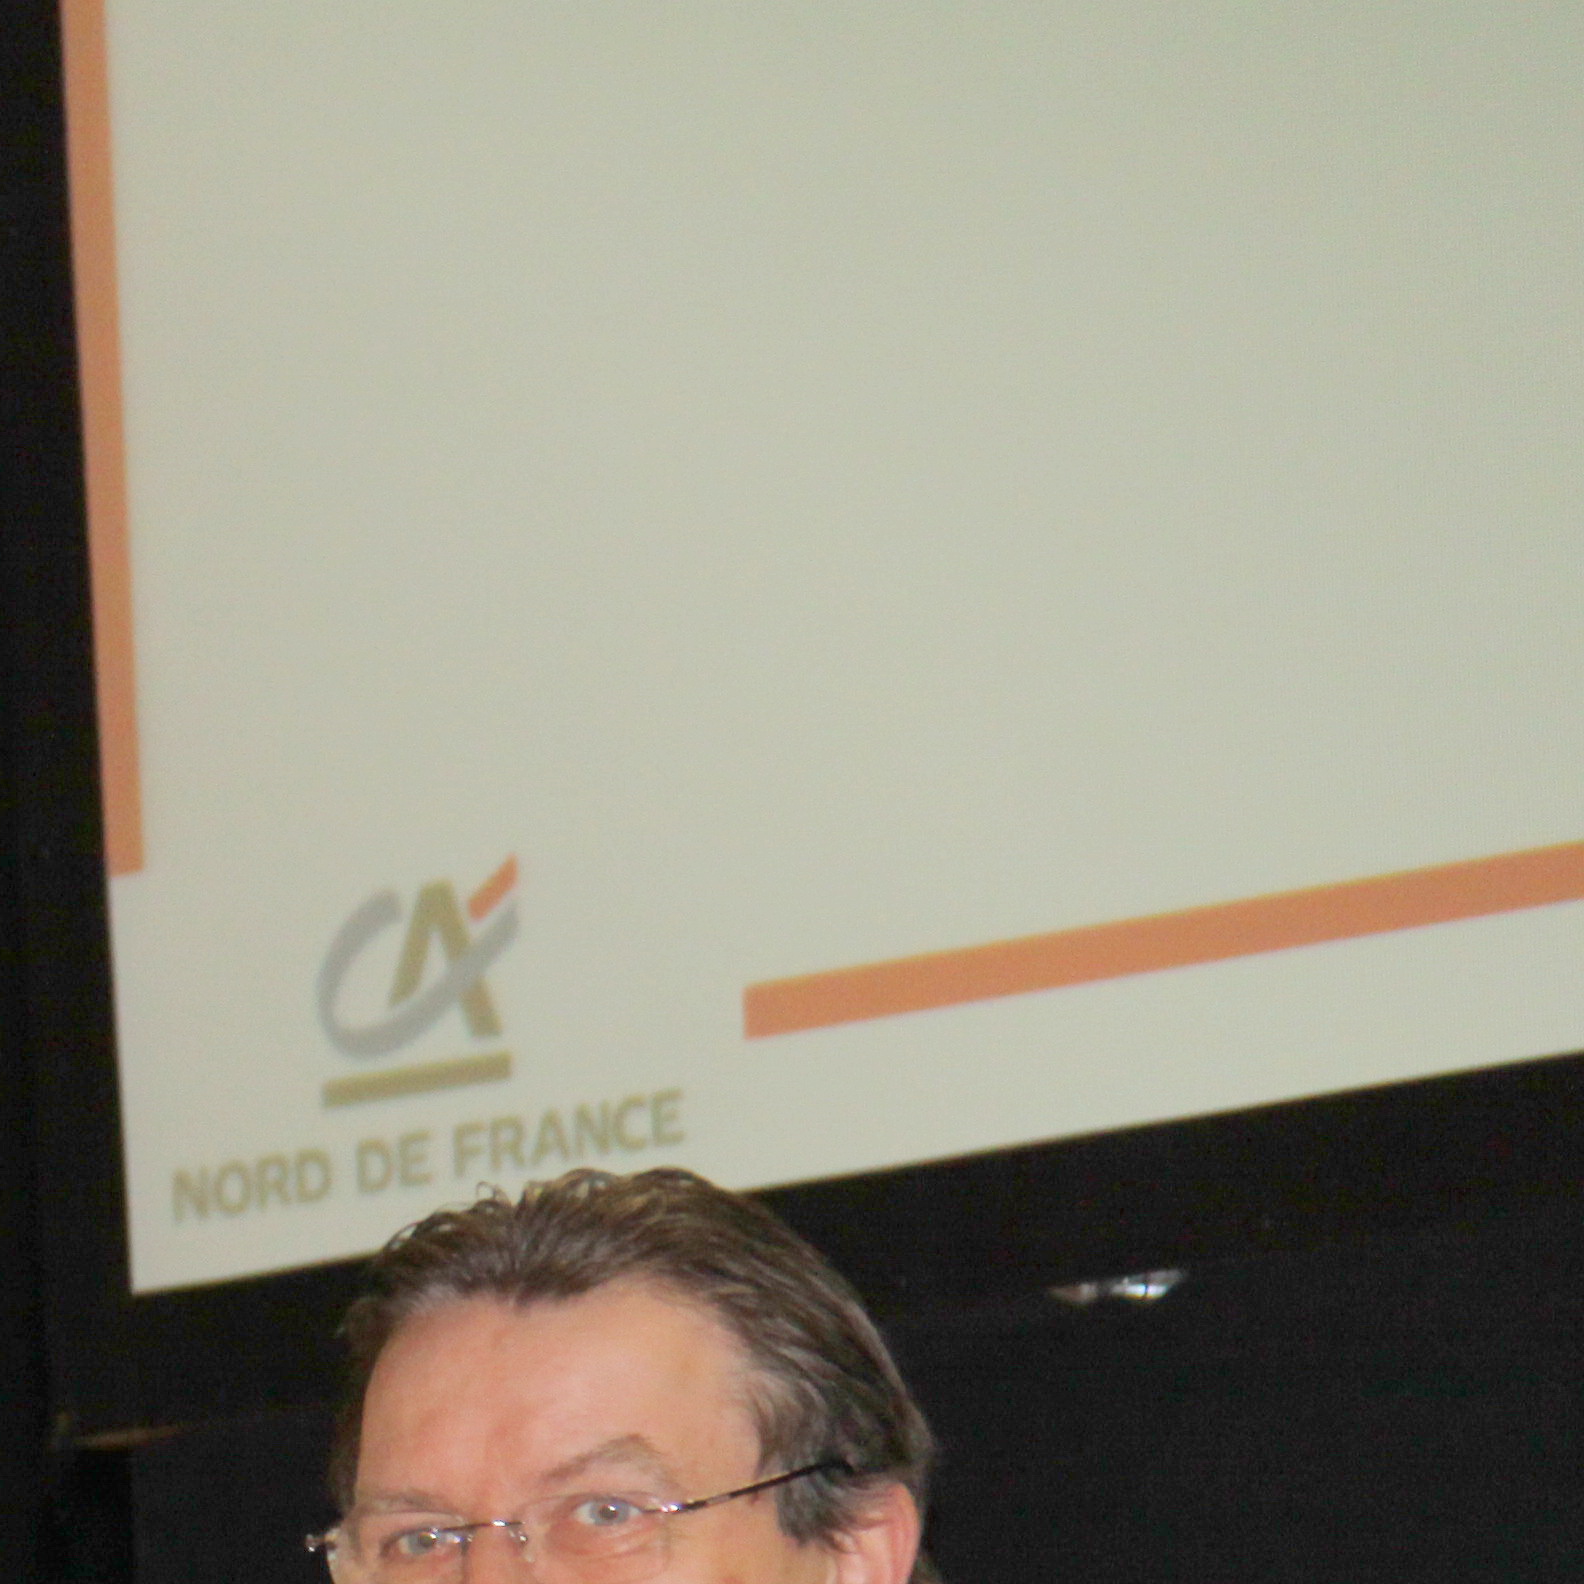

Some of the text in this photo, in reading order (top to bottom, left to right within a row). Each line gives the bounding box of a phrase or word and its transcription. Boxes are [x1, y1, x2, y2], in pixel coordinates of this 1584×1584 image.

[171, 1088, 686, 1225] NORD DE FRANCE
